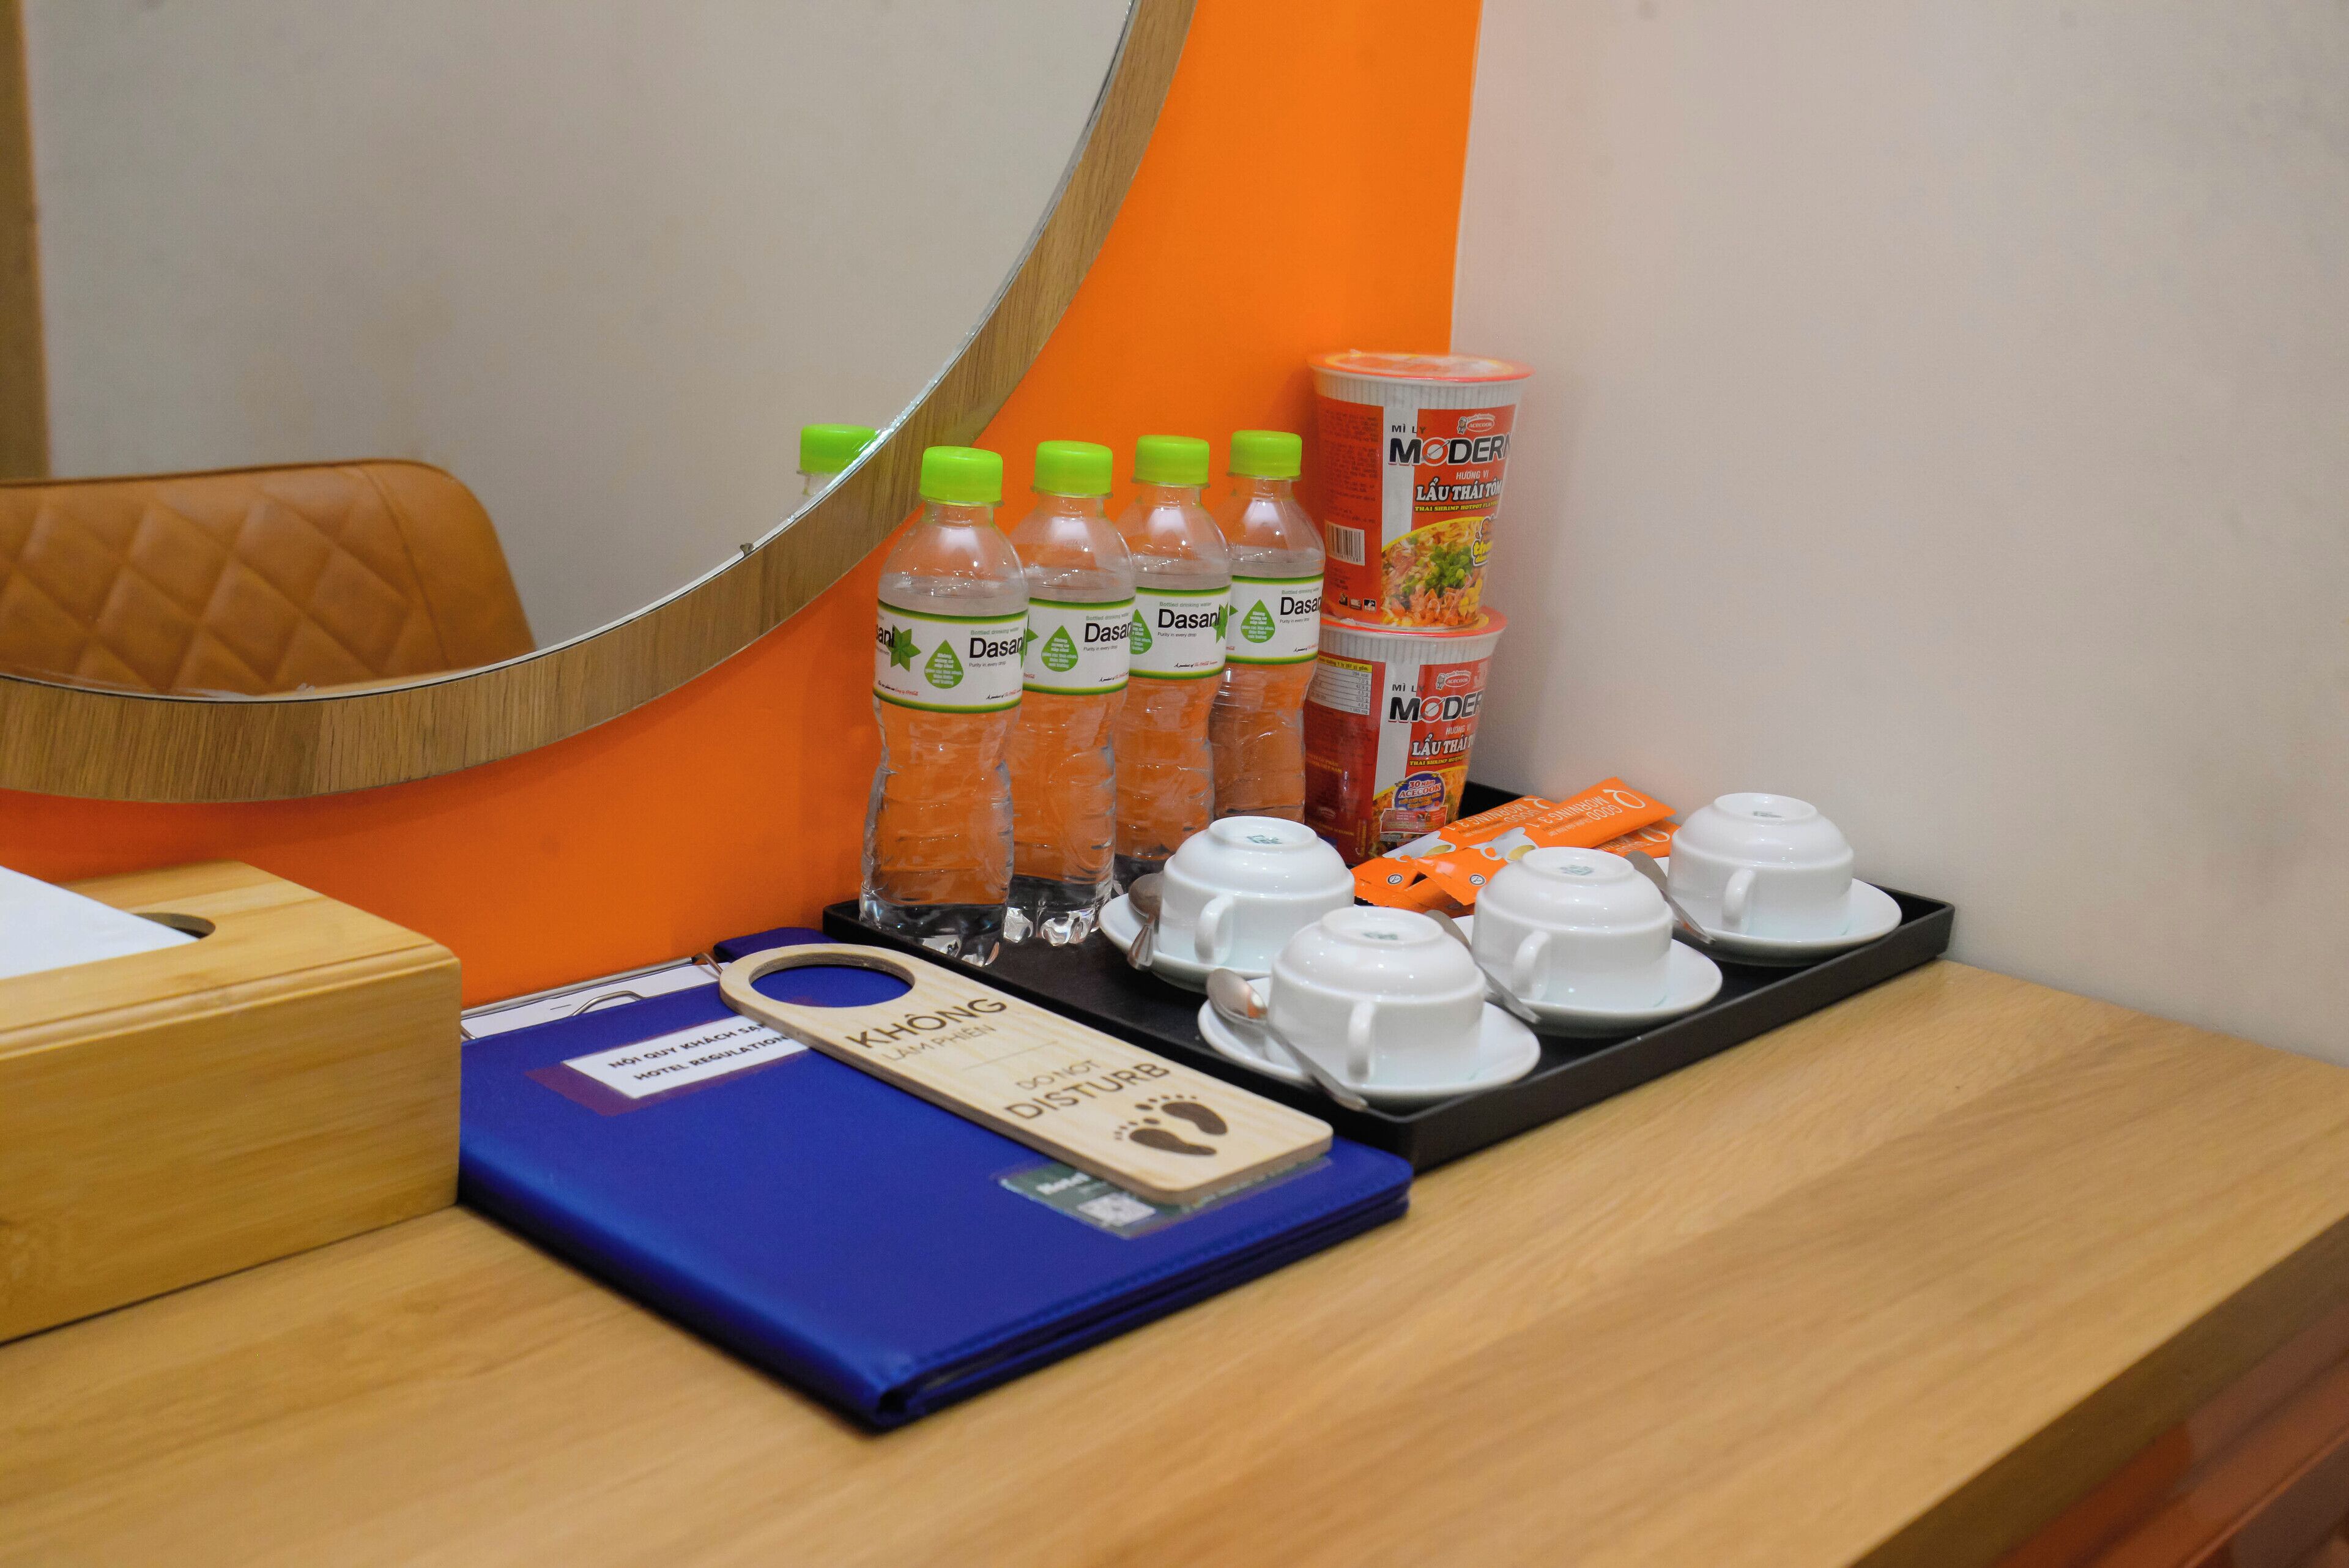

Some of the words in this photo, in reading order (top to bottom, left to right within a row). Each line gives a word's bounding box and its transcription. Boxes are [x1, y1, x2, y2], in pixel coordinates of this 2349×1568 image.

[1452, 480, 1484, 500] THÁI
[1399, 784, 1441, 798] ACECOOK
[1466, 803, 1529, 825] MORNING
[1548, 796, 1609, 821] MORNING
[1586, 804, 1623, 820] GOOD
[845, 999, 1008, 1048] KHÔNG
[608, 1055, 642, 1069] NỘI
[644, 1047, 678, 1060] QUY
[680, 1031, 738, 1050] KHÁCH
[634, 1063, 689, 1081] HOTEL
[1015, 1074, 1055, 1090] DO
[1052, 1060, 1100, 1079] NOT
[1004, 1063, 1170, 1120] DISTURB
